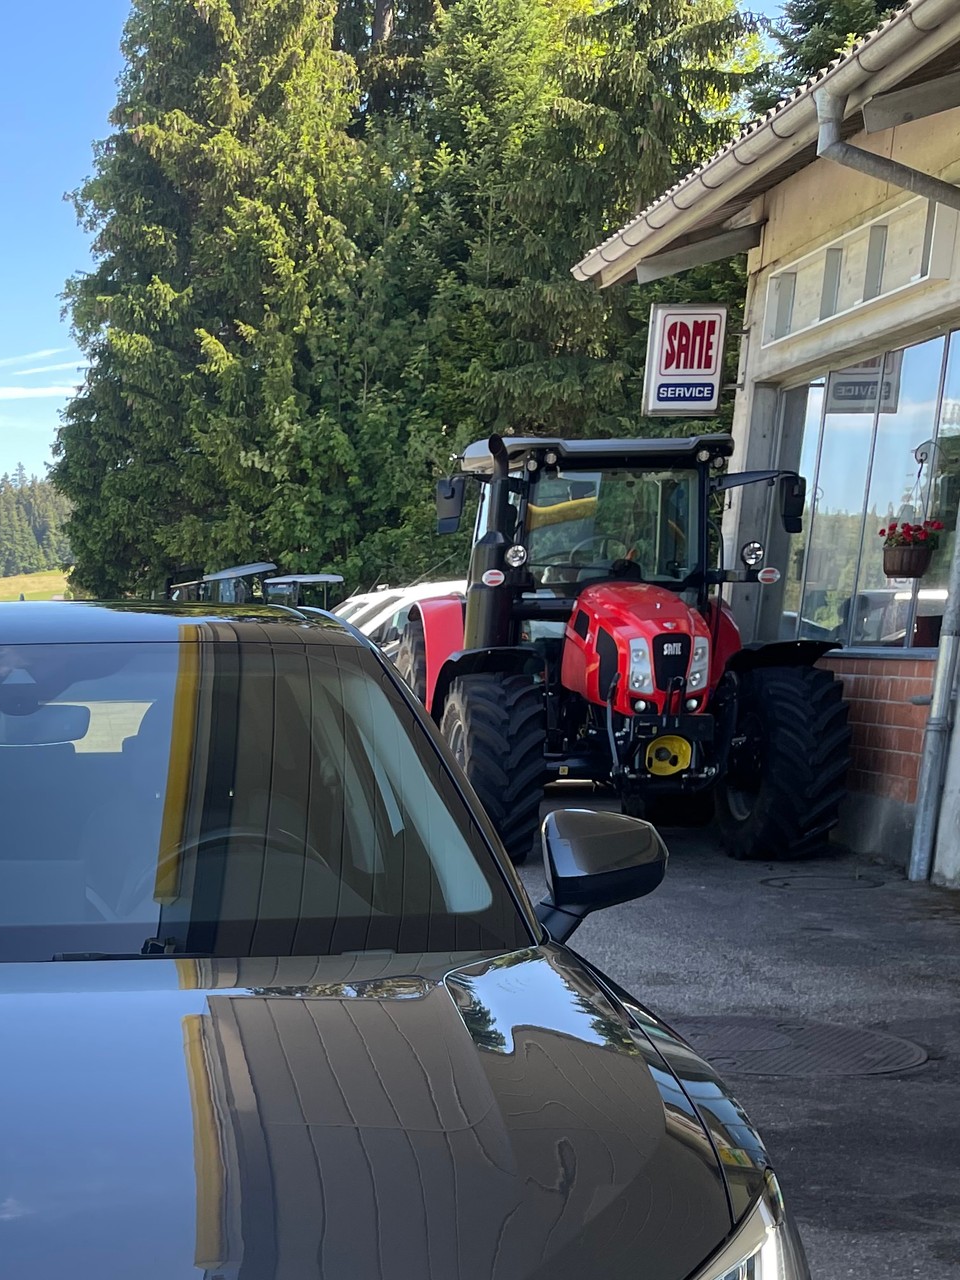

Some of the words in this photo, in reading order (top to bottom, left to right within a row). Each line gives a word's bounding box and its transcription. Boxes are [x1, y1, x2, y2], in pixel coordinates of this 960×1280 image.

[664, 319, 717, 370] SAME
[658, 386, 712, 398] SERVICE
[663, 643, 682, 655] SAME
